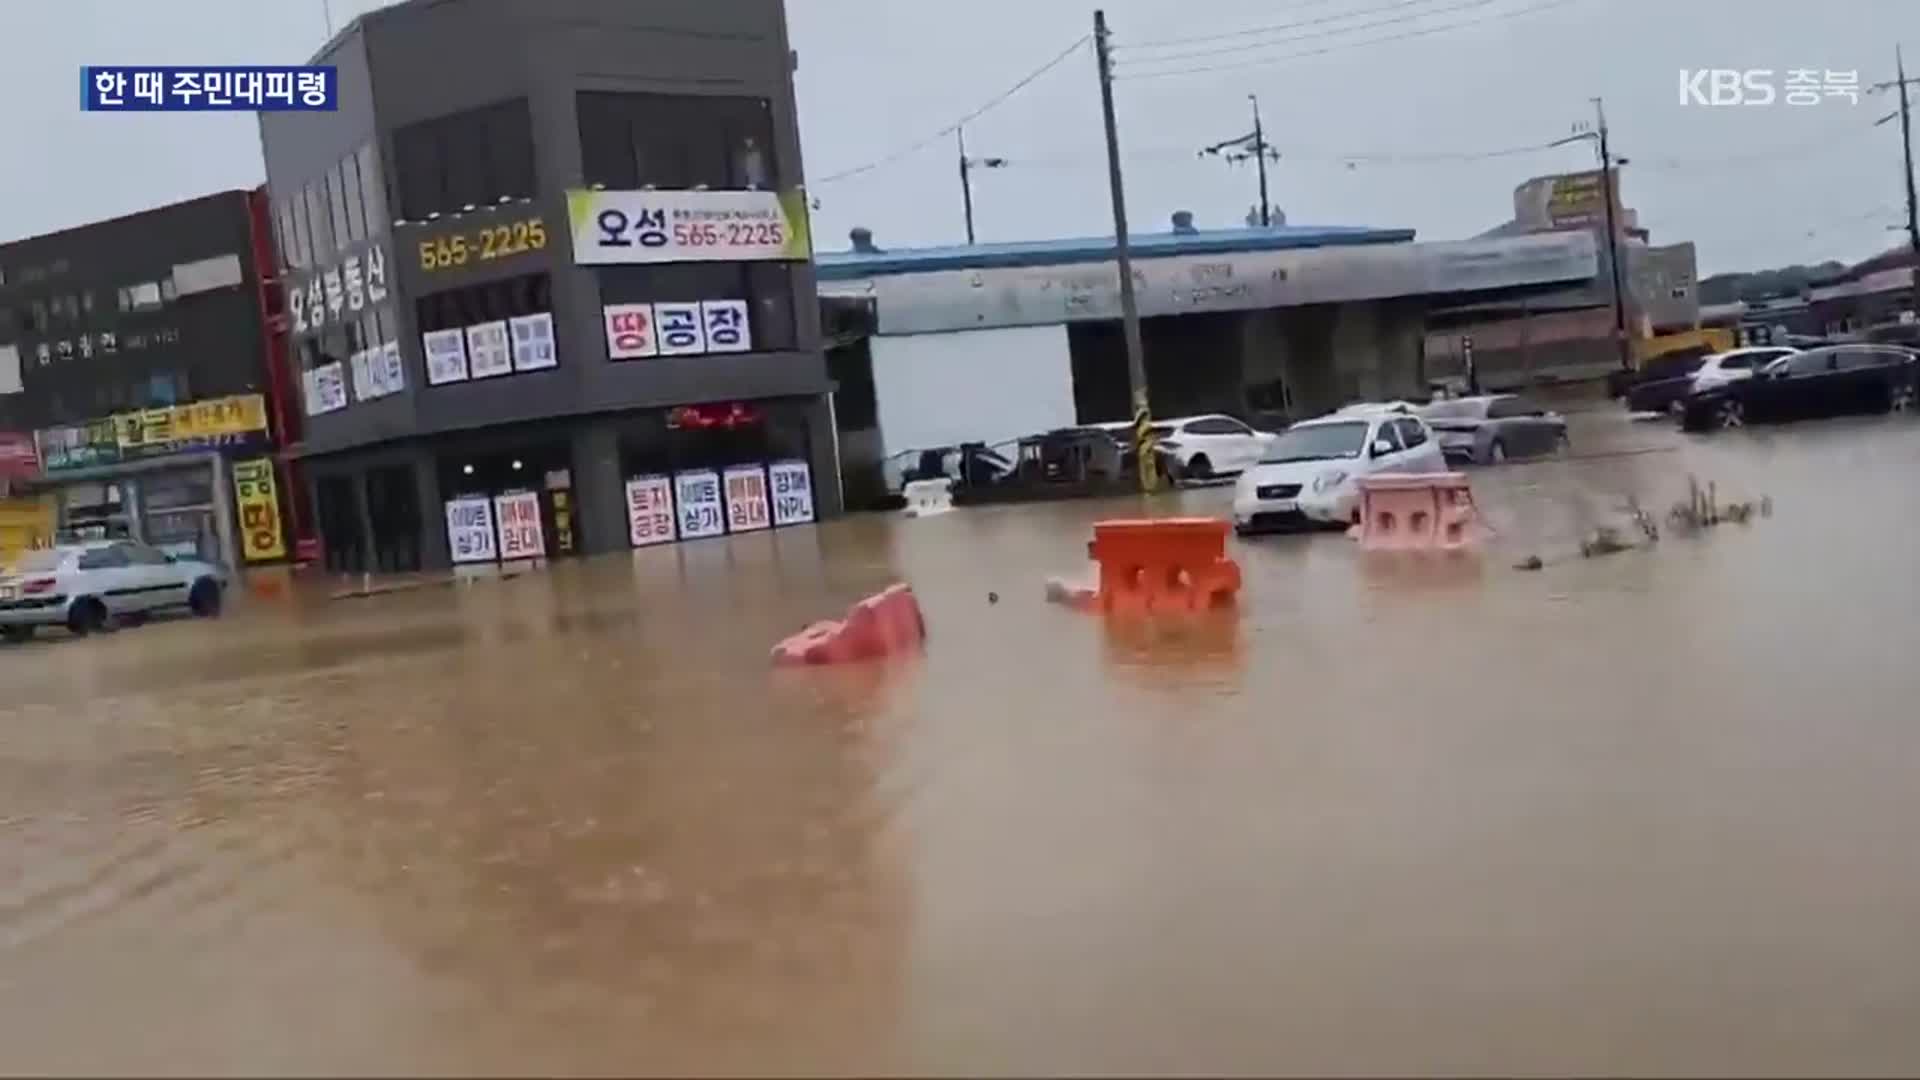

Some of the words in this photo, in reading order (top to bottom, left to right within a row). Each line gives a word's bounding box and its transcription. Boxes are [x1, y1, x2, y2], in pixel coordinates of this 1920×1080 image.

[598, 208, 668, 247] 오성
[673, 222, 785, 247] 565-2225
[419, 217, 546, 270] 565-2225
[290, 244, 387, 333] 오성부동산
[686, 507, 718, 531] 상가
[778, 496, 810, 520] NPL
[459, 530, 490, 554] 상가
